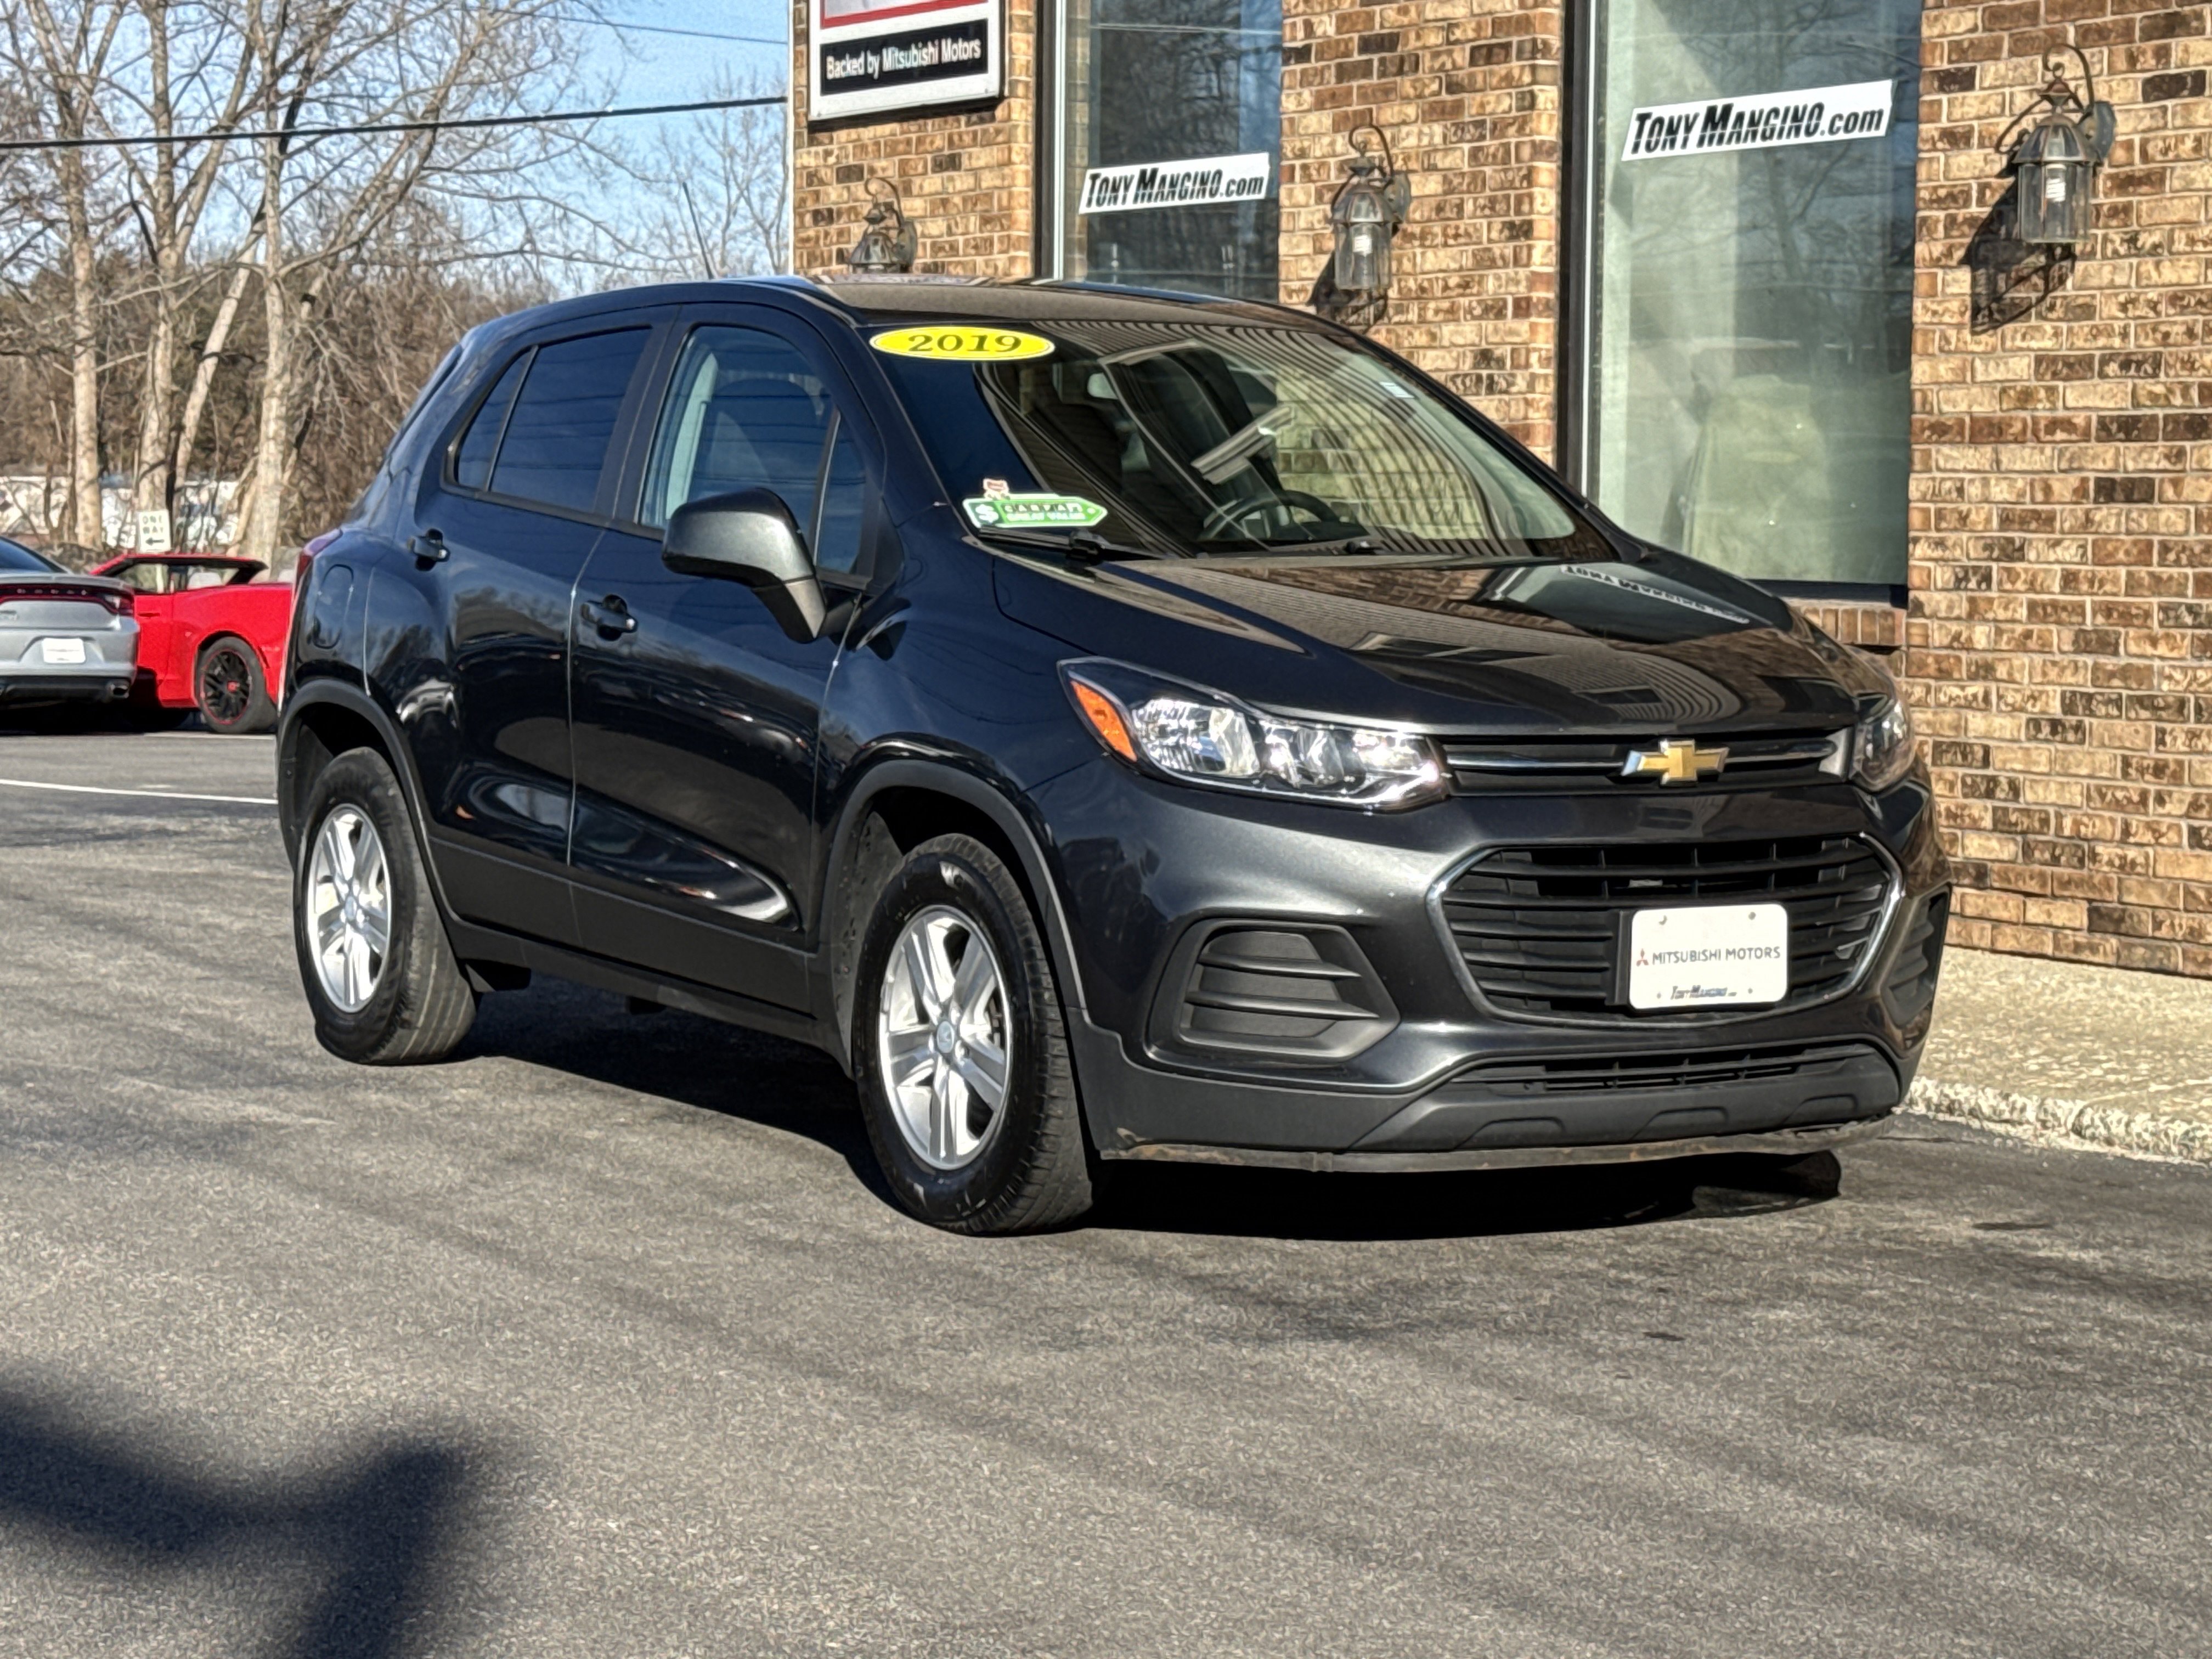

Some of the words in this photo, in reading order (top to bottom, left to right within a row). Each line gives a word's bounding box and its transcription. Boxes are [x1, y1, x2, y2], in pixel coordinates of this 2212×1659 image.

[826, 50, 865, 80] Backed
[867, 49, 881, 80] by
[882, 40, 939, 72] Mitsubishi
[941, 37, 981, 64] Motors
[907, 334, 1022, 353] 2019
[1652, 948, 1722, 965] MITSUBISHI
[1725, 946, 1781, 961] MOTORS
